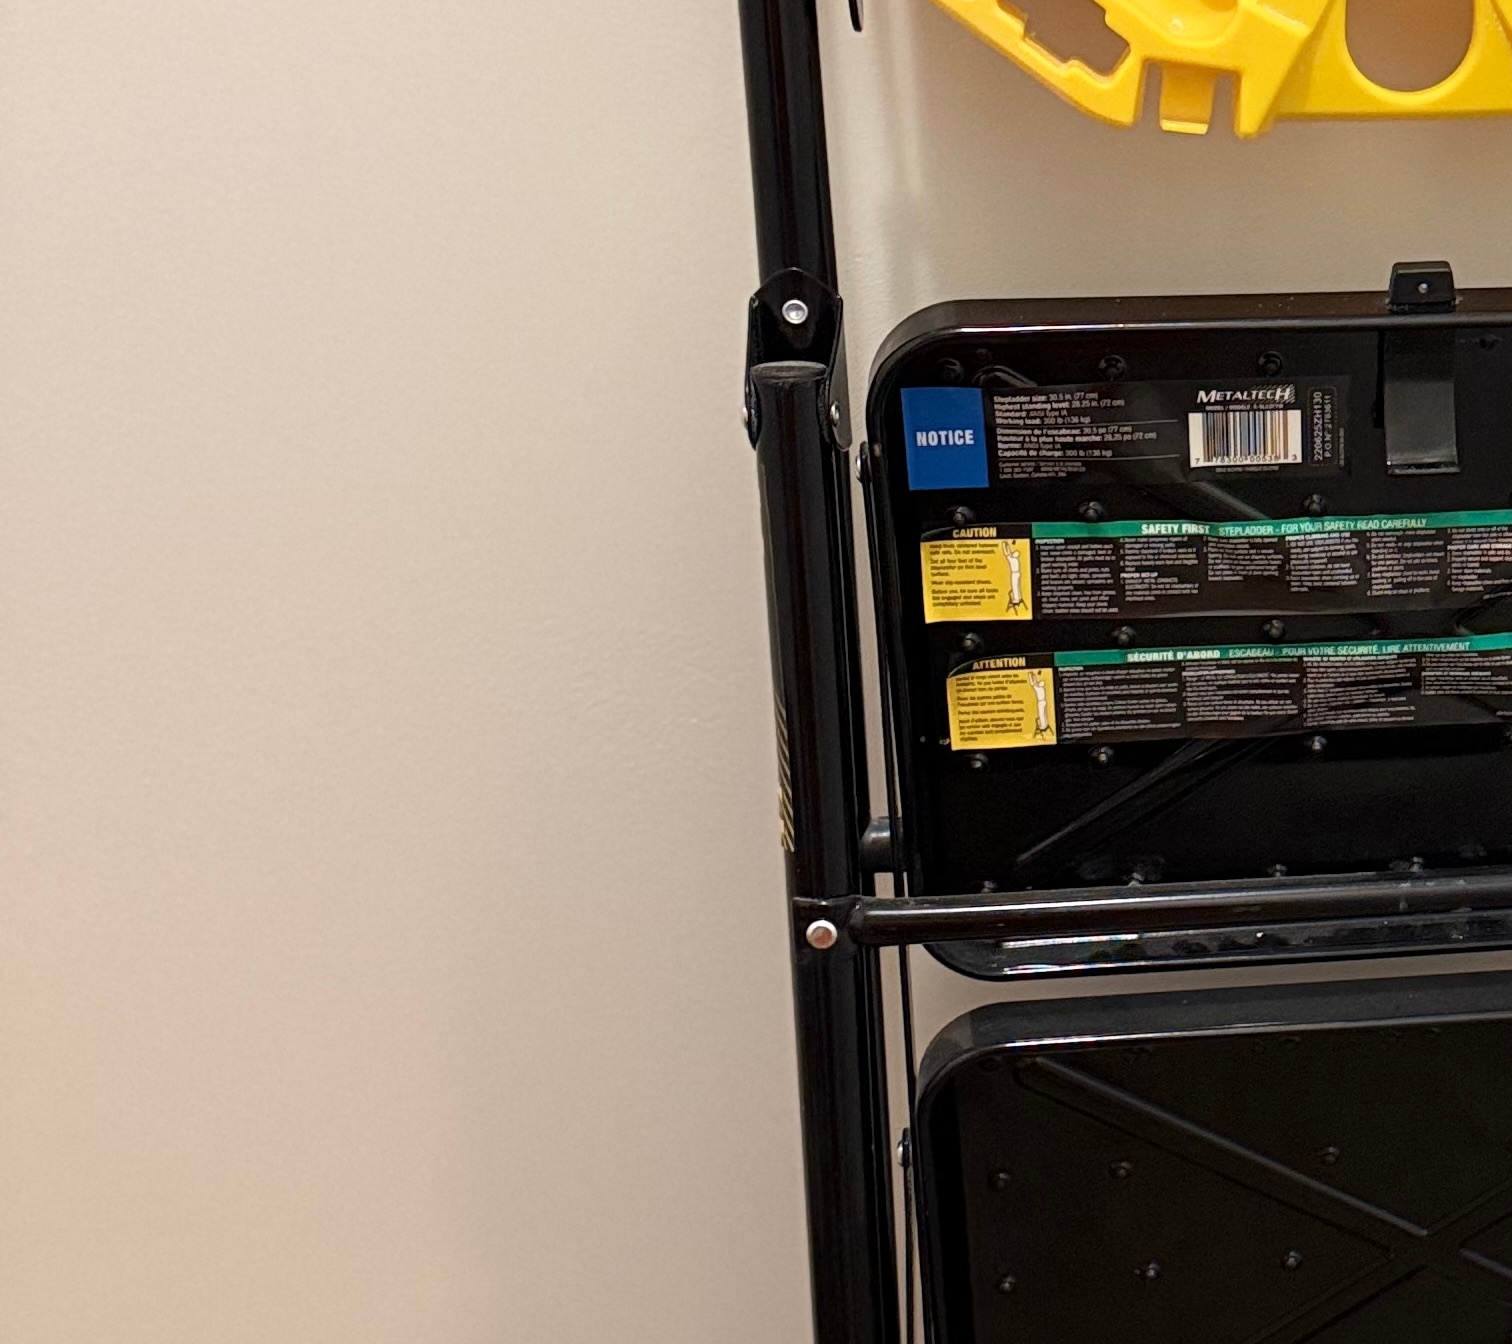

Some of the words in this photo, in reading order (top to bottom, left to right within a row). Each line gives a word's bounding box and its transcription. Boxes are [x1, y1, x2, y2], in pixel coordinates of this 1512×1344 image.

[916, 429, 975, 446] NOTICE
[952, 527, 997, 538] CAUTION
[1141, 523, 1179, 535] SAFETY
[1182, 523, 1210, 535] FIRST
[1218, 526, 1273, 536] STEPLADDER
[1281, 523, 1298, 533] FOR
[1299, 522, 1322, 532] YOUR
[1323, 520, 1355, 531] SAFETY
[1357, 519, 1379, 530] READ
[1381, 518, 1427, 529] CAREFULLY
[1127, 650, 1174, 662] SÉCURITÉ
[1177, 650, 1220, 660] D'ABORD
[1228, 649, 1274, 658] ESCABEAU
[1282, 647, 1306, 656] POUR
[1308, 646, 1335, 655] VOTRE
[1382, 644, 1400, 653] LIRE
[1402, 642, 1470, 653] ATTENTIVEMENT
[972, 657, 1026, 671] ATTENTION
